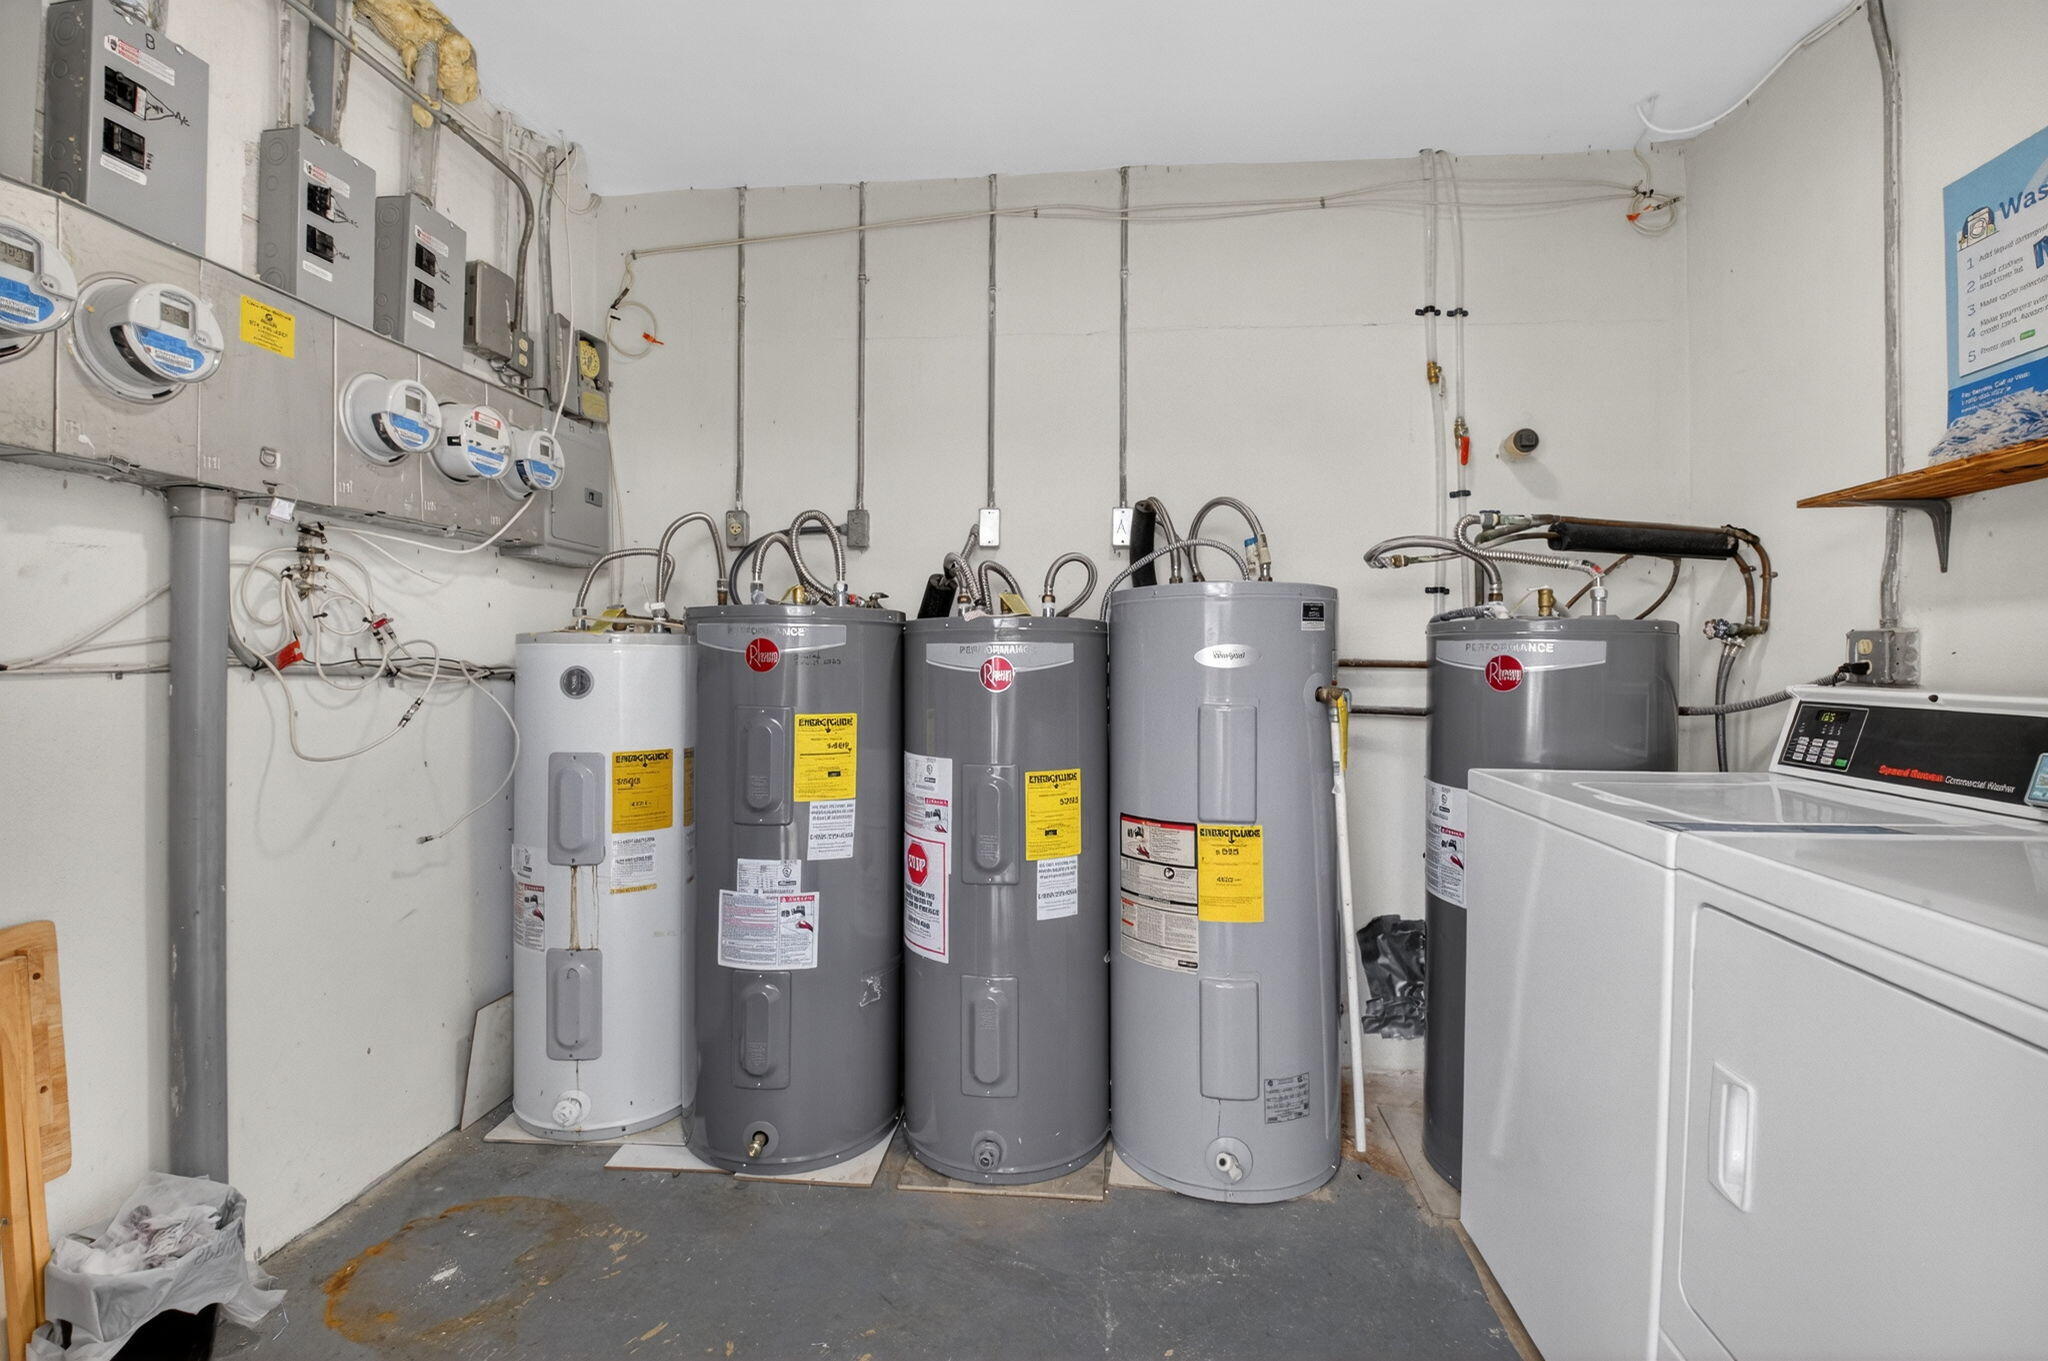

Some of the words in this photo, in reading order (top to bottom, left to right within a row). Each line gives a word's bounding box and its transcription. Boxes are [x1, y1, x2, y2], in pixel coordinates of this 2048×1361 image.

[1966, 257, 1975, 271] 1
[1966, 280, 1976, 294] 2
[1967, 303, 1976, 317] 3
[1966, 327, 1976, 338] 4
[1967, 350, 1977, 363] 5
